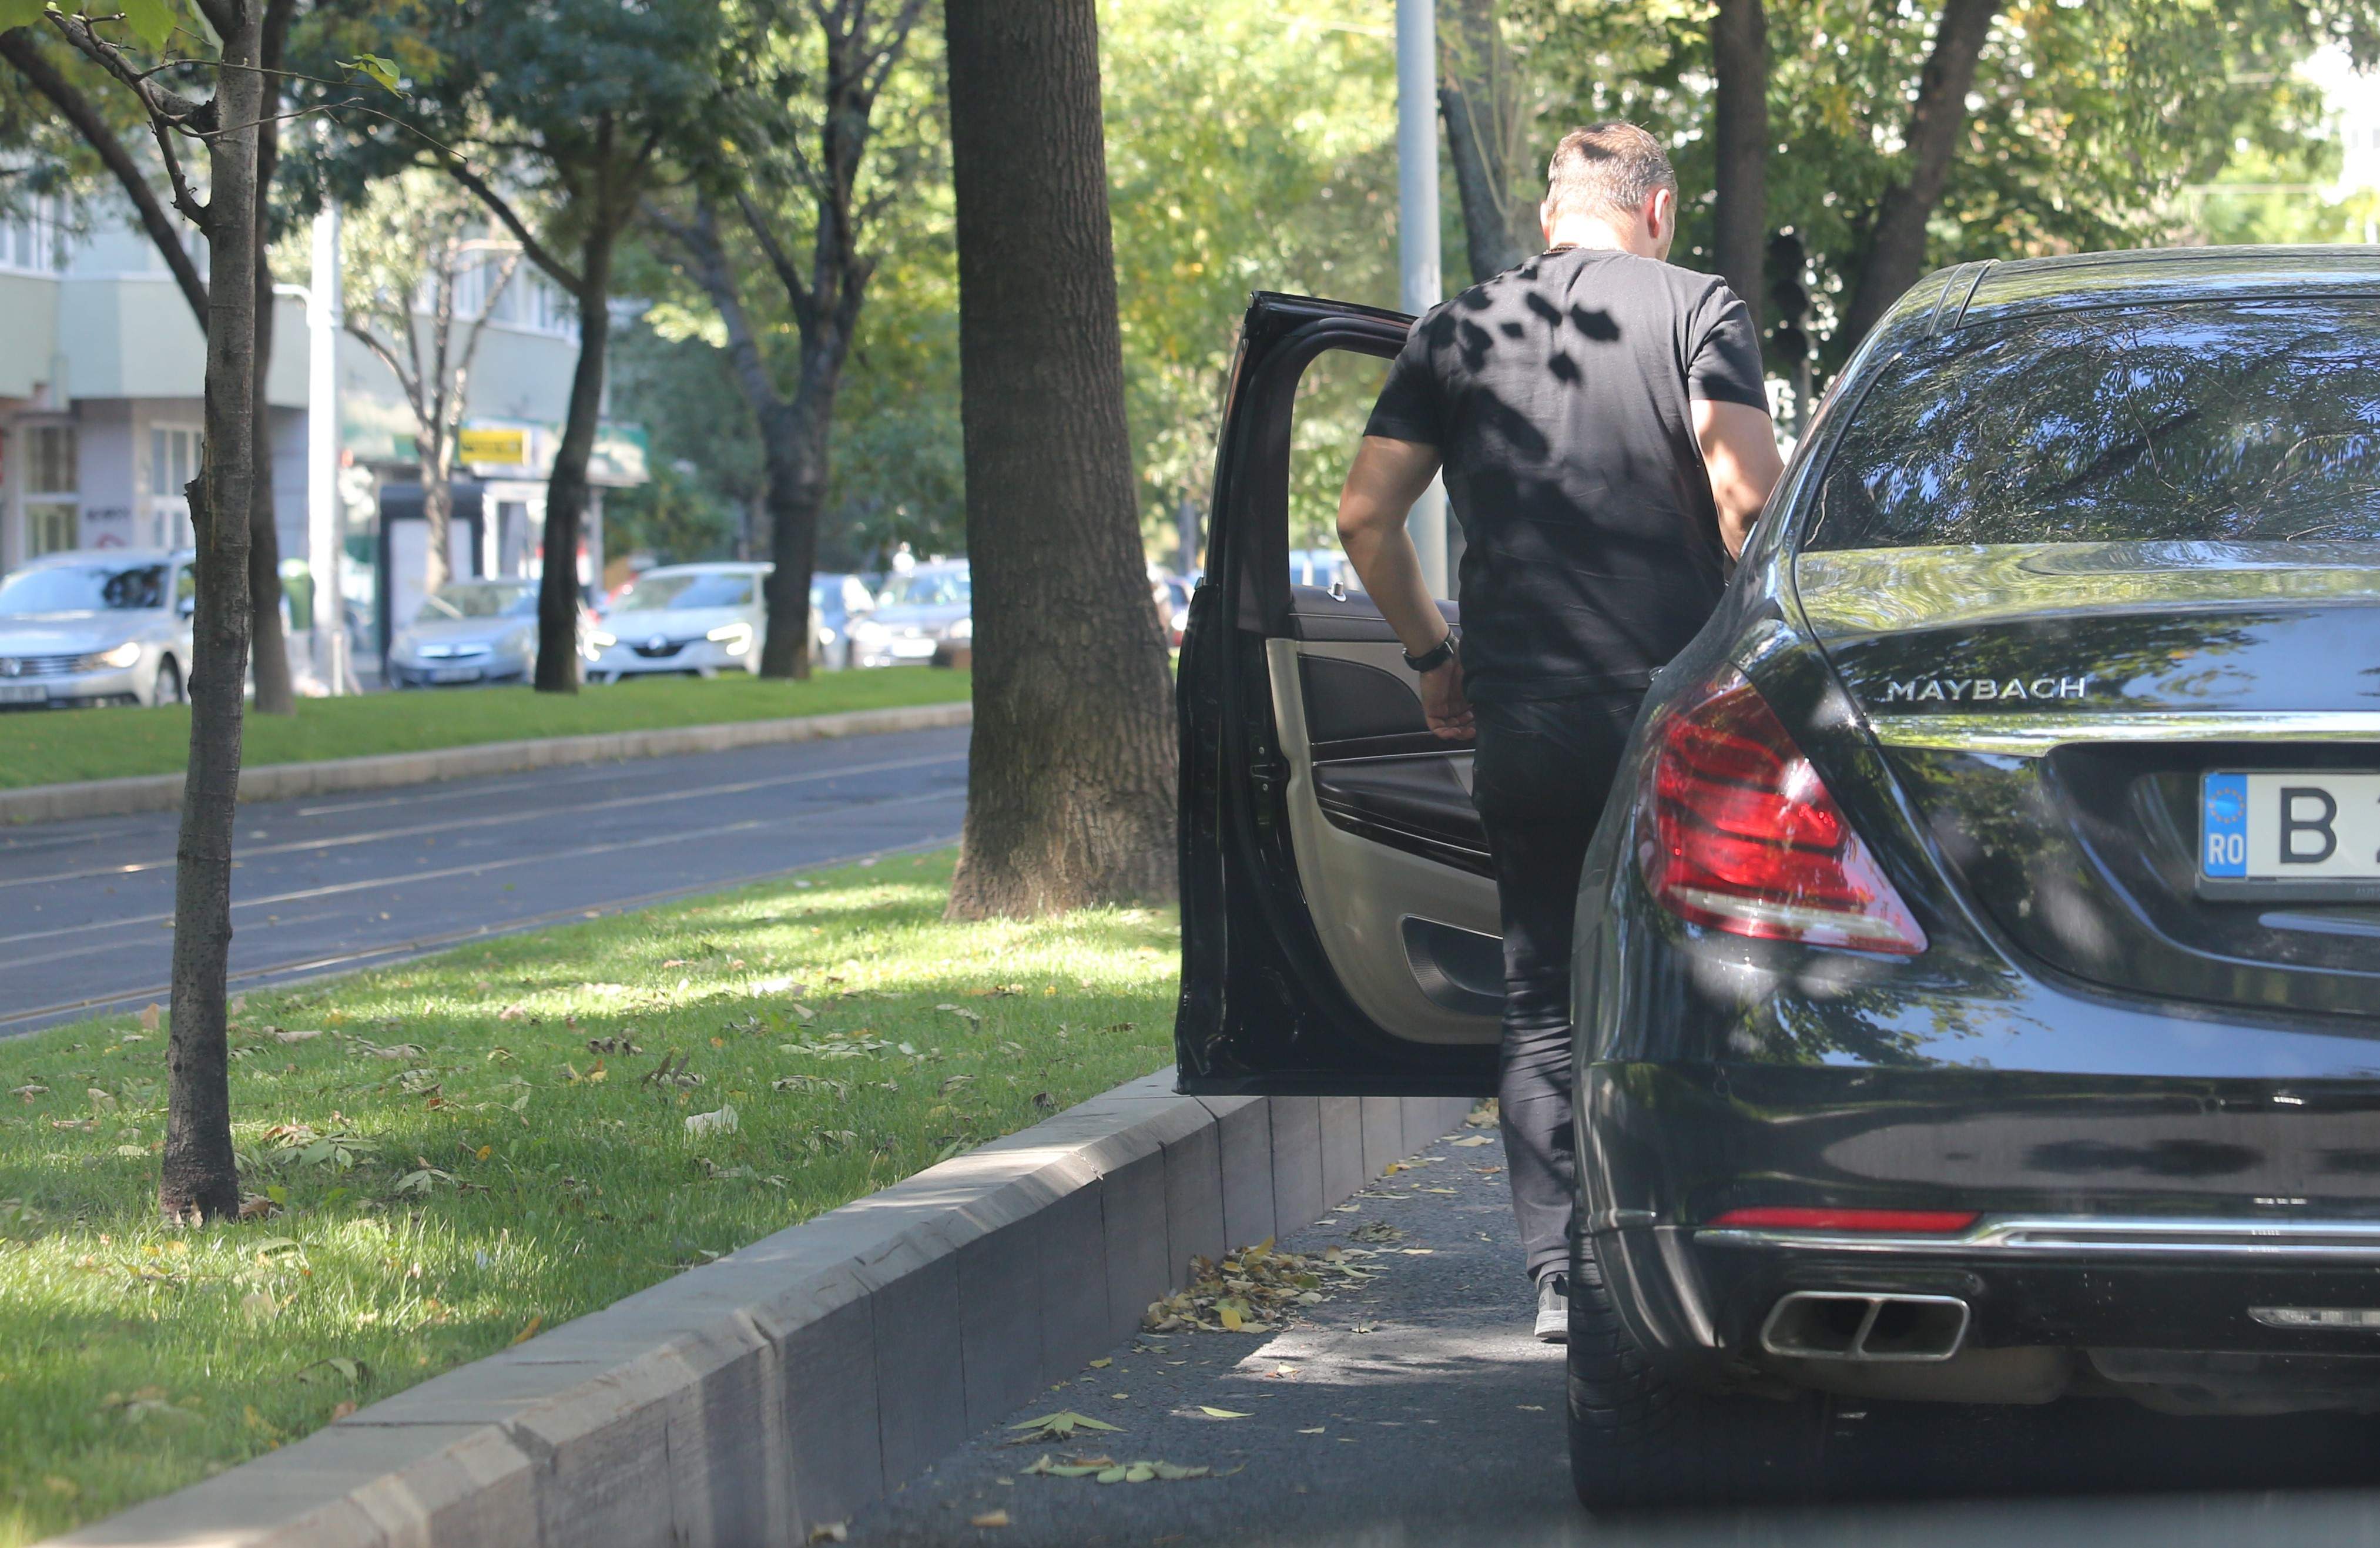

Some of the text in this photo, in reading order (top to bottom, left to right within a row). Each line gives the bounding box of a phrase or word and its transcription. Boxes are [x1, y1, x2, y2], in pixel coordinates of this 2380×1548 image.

[1886, 677, 2085, 702] MAYBACH
[2280, 788, 2337, 864] B
[2208, 833, 2245, 865] RO
